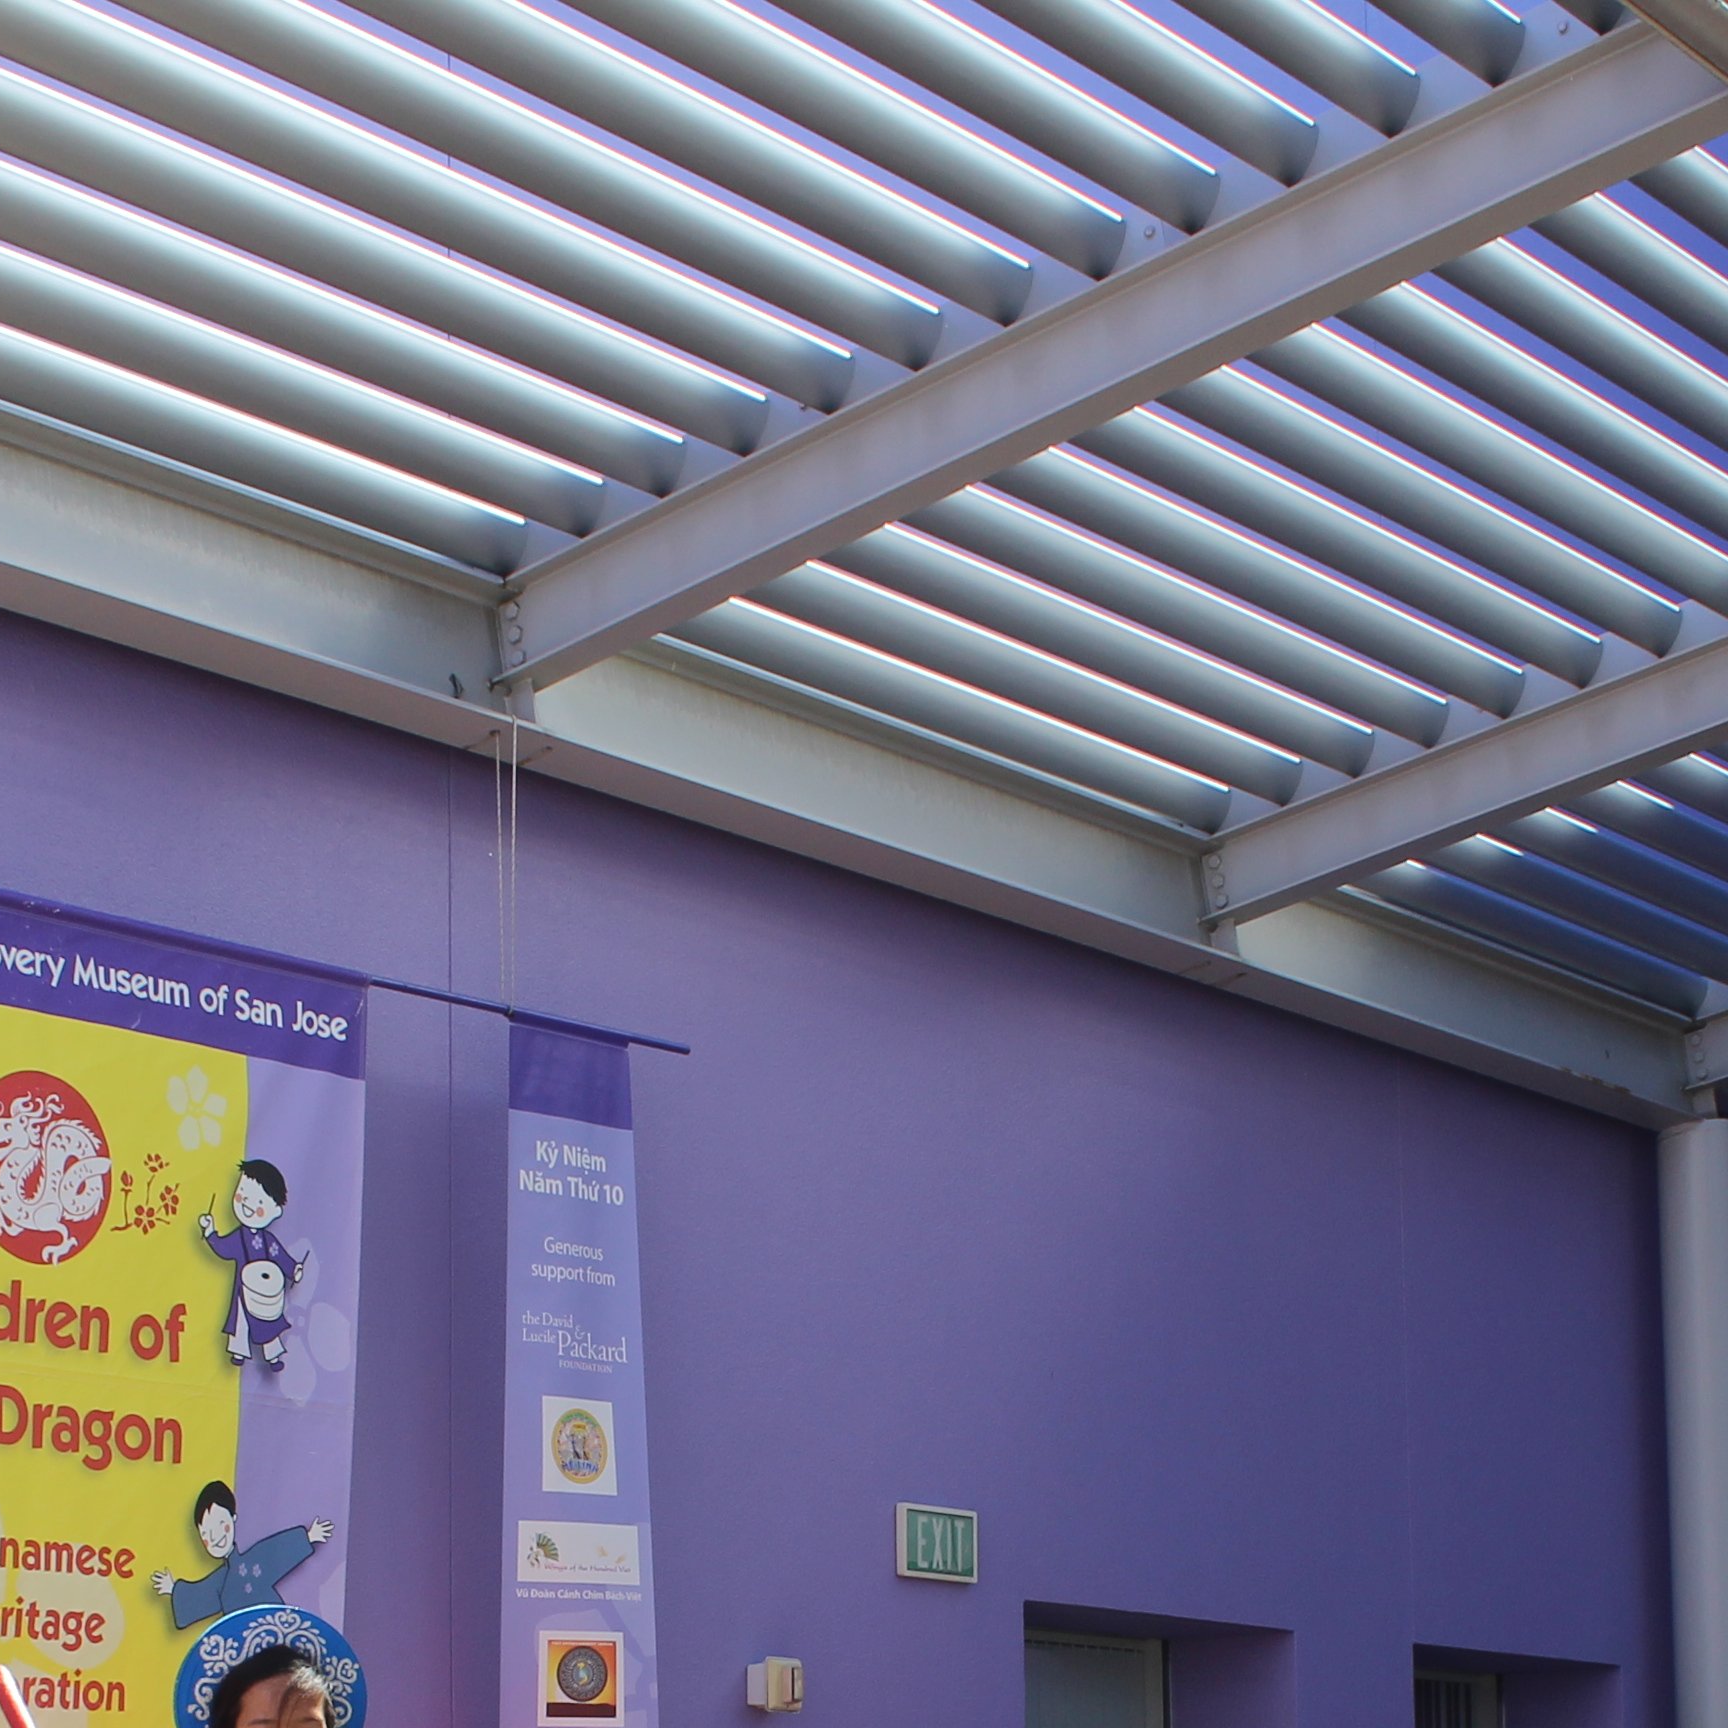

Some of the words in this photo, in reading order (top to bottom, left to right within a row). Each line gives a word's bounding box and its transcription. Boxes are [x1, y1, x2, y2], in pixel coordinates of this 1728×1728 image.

[73, 954, 190, 1008] Museum
[199, 984, 228, 1015] of
[235, 988, 283, 1028] San
[292, 1001, 348, 1041] Jose
[536, 1140, 559, 1169] Kỷ
[563, 1144, 607, 1175] Niệm
[519, 1169, 563, 1196] Năm
[567, 1175, 600, 1203] Thứ
[603, 1184, 624, 1206] 10
[544, 1236, 604, 1262] Generous
[531, 1262, 585, 1284] support
[586, 1267, 615, 1287] from
[130, 1303, 186, 1363] of
[522, 1311, 540, 1325] the
[542, 1311, 573, 1328] David
[522, 1328, 556, 1344] Lucile
[557, 1330, 628, 1363] Packard
[559, 1358, 612, 1373] FOUNDATION
[917, 1516, 965, 1572] EXIT
